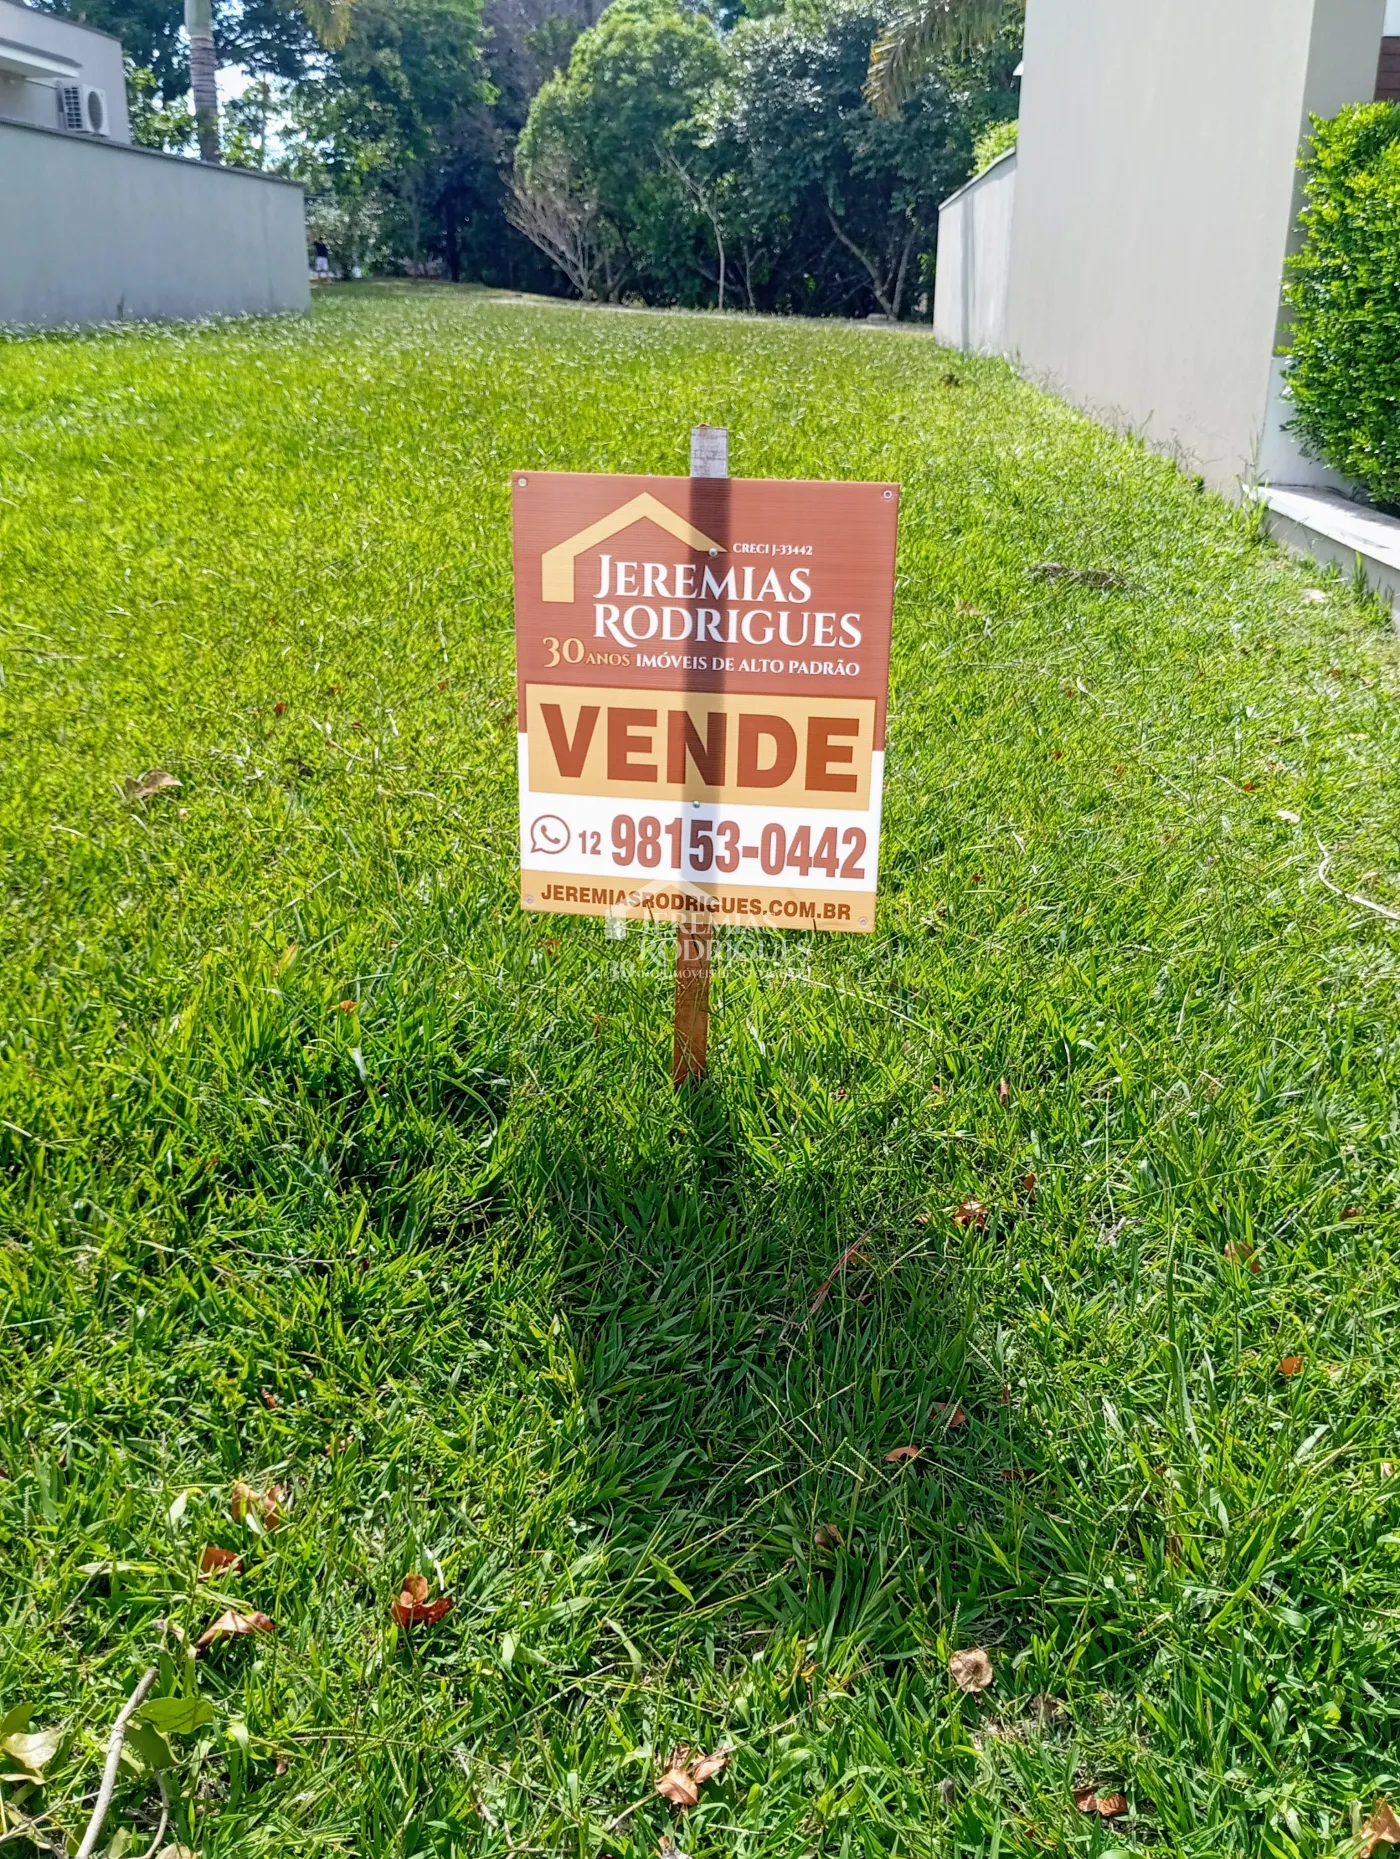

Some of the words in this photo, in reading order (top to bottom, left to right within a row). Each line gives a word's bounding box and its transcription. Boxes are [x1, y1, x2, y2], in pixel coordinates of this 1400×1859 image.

[732, 542, 769, 555] CRECI
[771, 544, 813, 557] J-33442
[593, 554, 812, 604] JEREMIAS
[593, 603, 862, 648] RODRIGUES
[542, 636, 585, 668] 30
[585, 652, 631, 667] ANOS
[635, 651, 708, 671] IMÓVEIS
[711, 657, 735, 672] DE
[737, 658, 784, 673] ALTO
[788, 659, 860, 677] PADRÃO
[540, 703, 860, 793] VENDE
[578, 830, 602, 856] 12
[610, 814, 867, 880] 98153-0442
[541, 883, 852, 921] JEREMIASRODRIGUES.COM.BR
